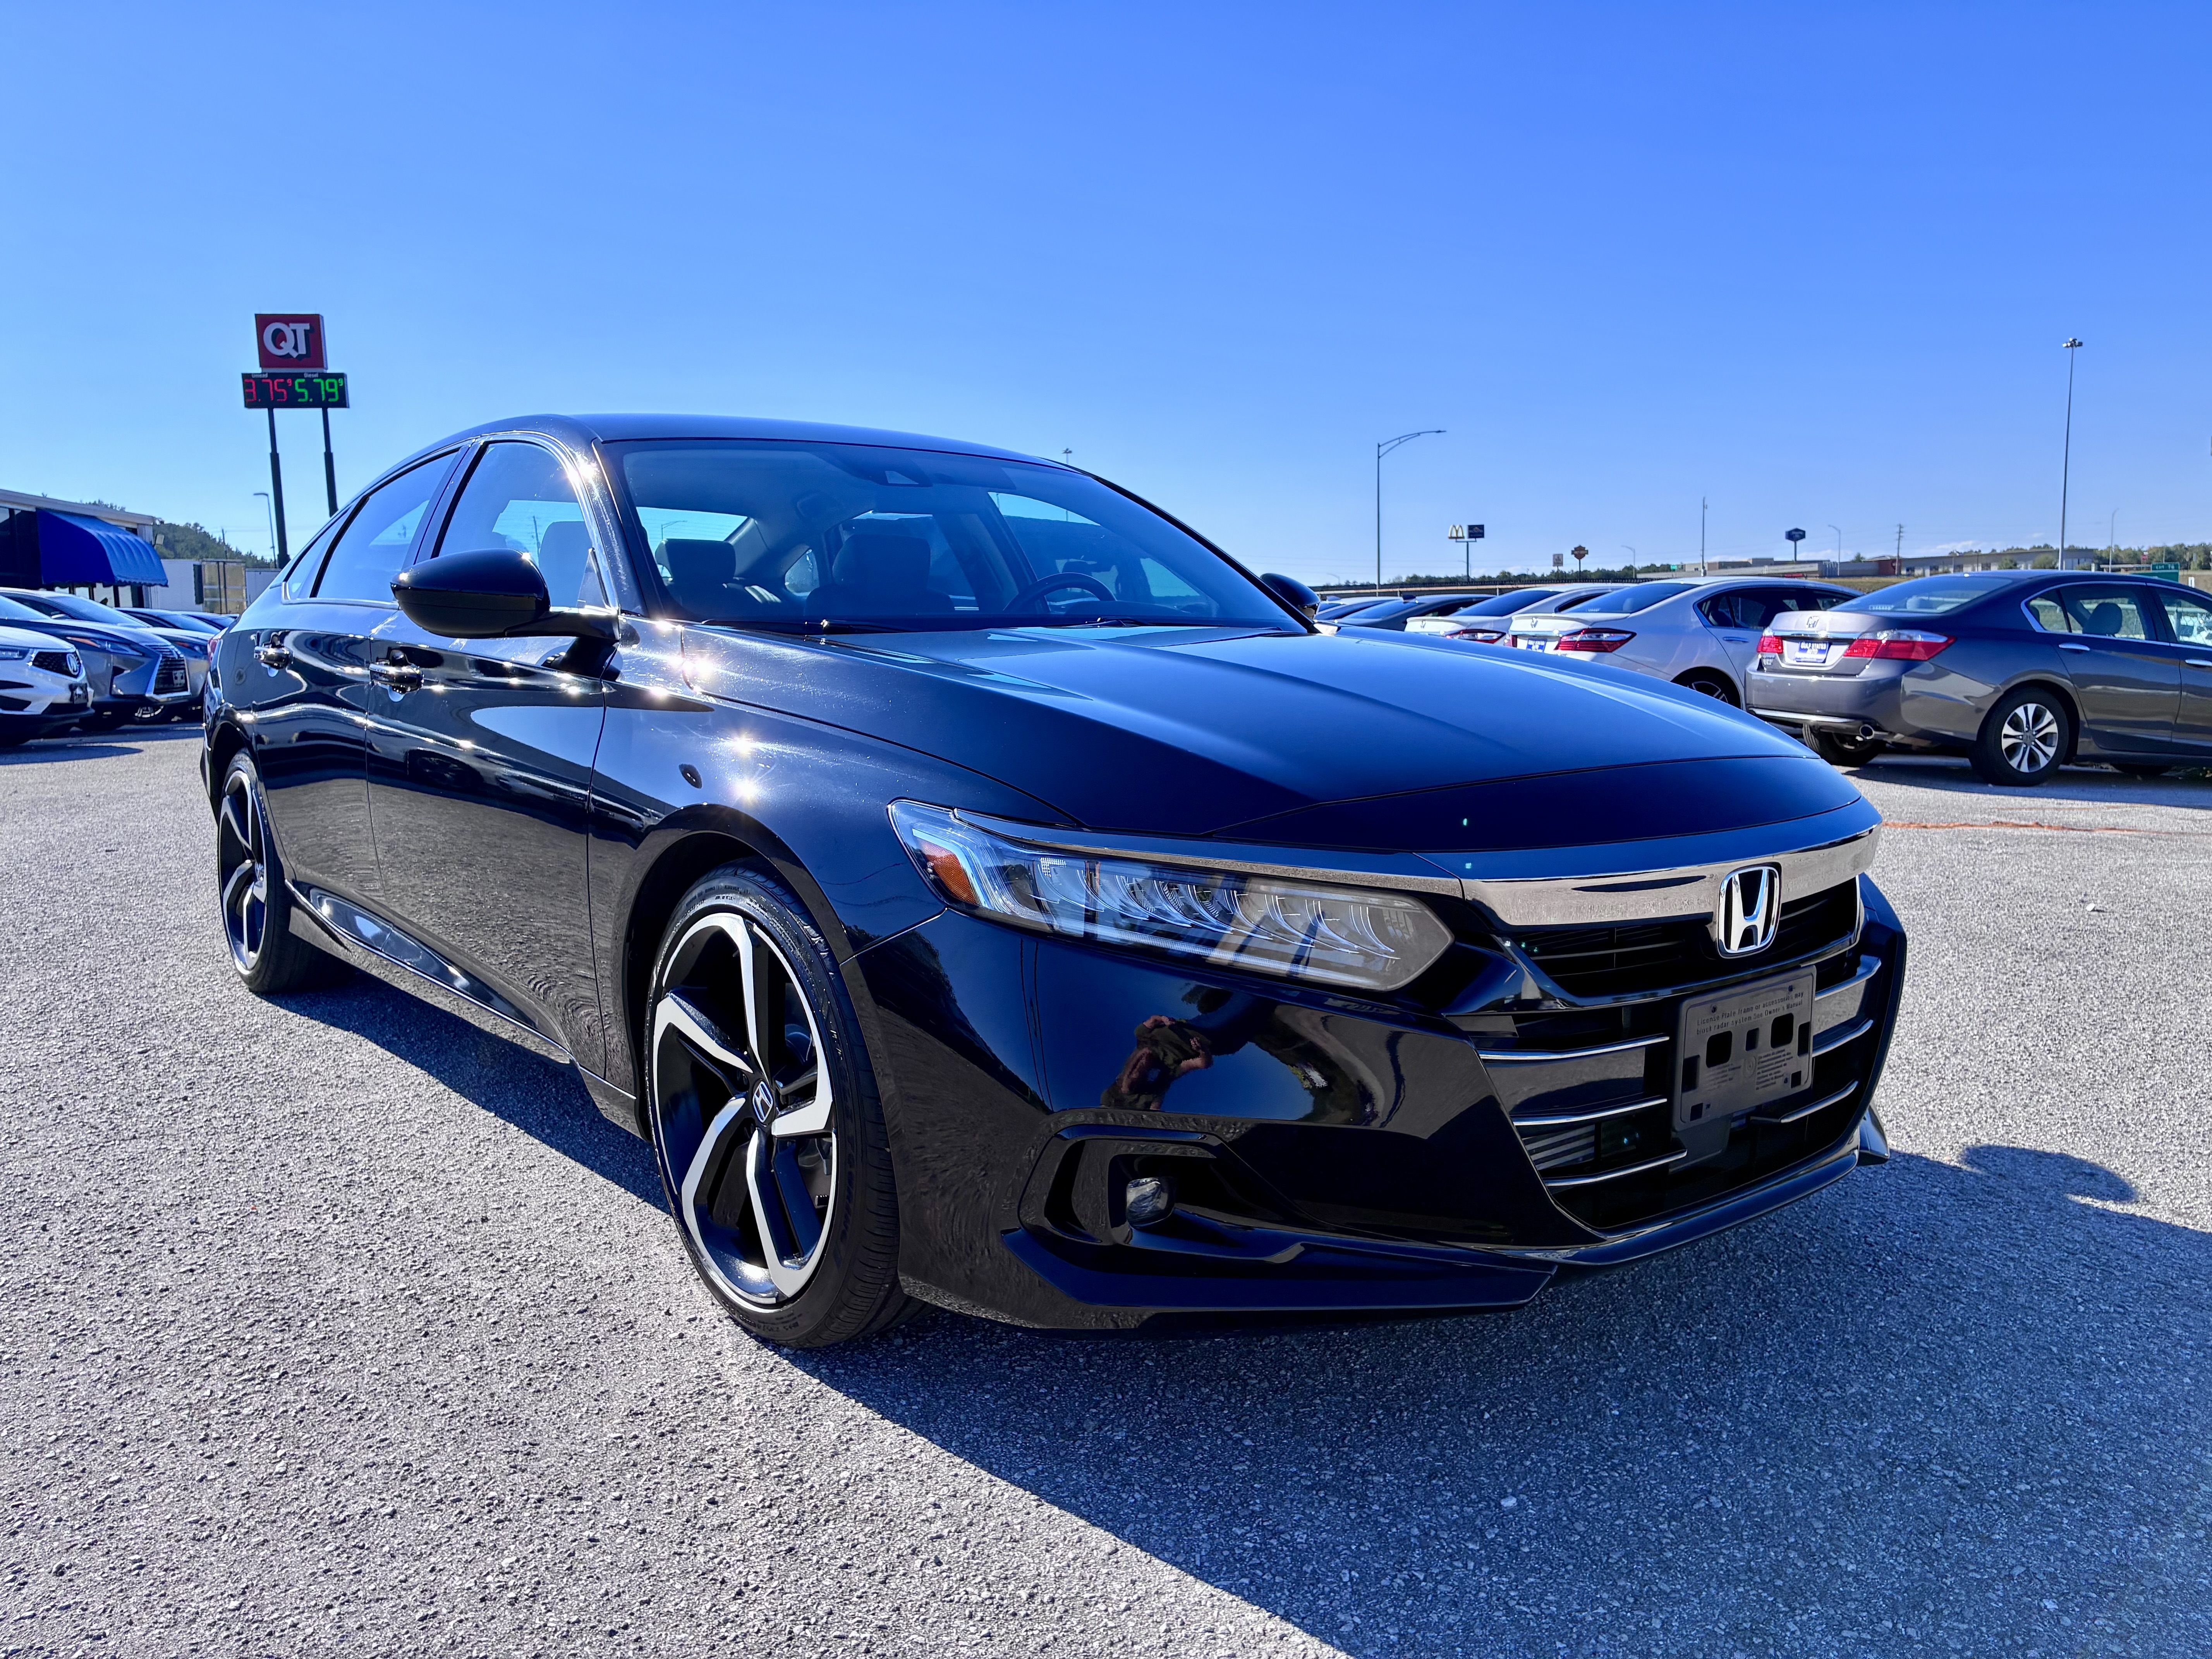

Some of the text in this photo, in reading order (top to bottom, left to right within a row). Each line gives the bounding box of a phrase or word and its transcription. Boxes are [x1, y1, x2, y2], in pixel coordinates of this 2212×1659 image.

[263, 322, 309, 358] QT
[1697, 1015, 1719, 1025] License
[1722, 1011, 1735, 1019] Plate
[1697, 1025, 1711, 1035] block
[1714, 1022, 1728, 1030] radar
